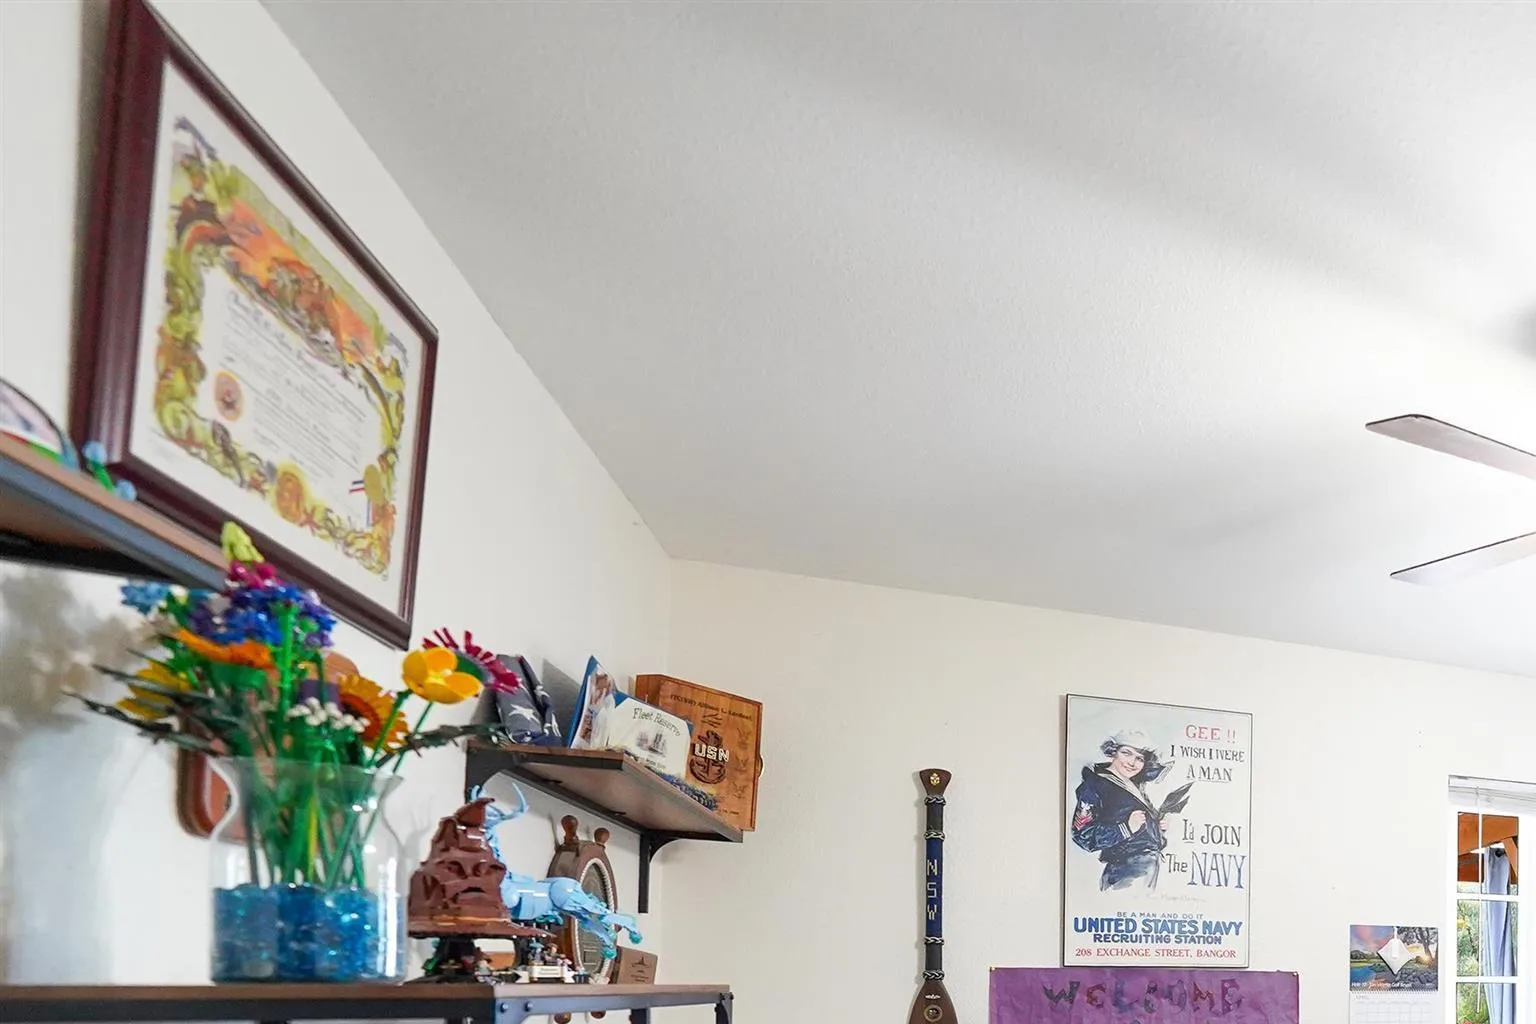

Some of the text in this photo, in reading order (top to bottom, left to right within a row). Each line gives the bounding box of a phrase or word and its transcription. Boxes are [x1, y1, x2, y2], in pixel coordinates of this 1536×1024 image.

[1185, 724, 1220, 740] GEE
[694, 743, 729, 762] USN
[1170, 744, 1245, 762] I WISH I WERE
[1186, 764, 1232, 781] A MAN
[1200, 823, 1242, 847] JOIN
[1165, 850, 1247, 889] The NAVY
[1073, 917, 1243, 936] UNITED STATES NAVY
[1093, 933, 1222, 945] RECRUITING STATION
[1075, 948, 1092, 957] 208
[1096, 948, 1150, 957] EXCHANGE
[1196, 949, 1236, 958] BANGOR
